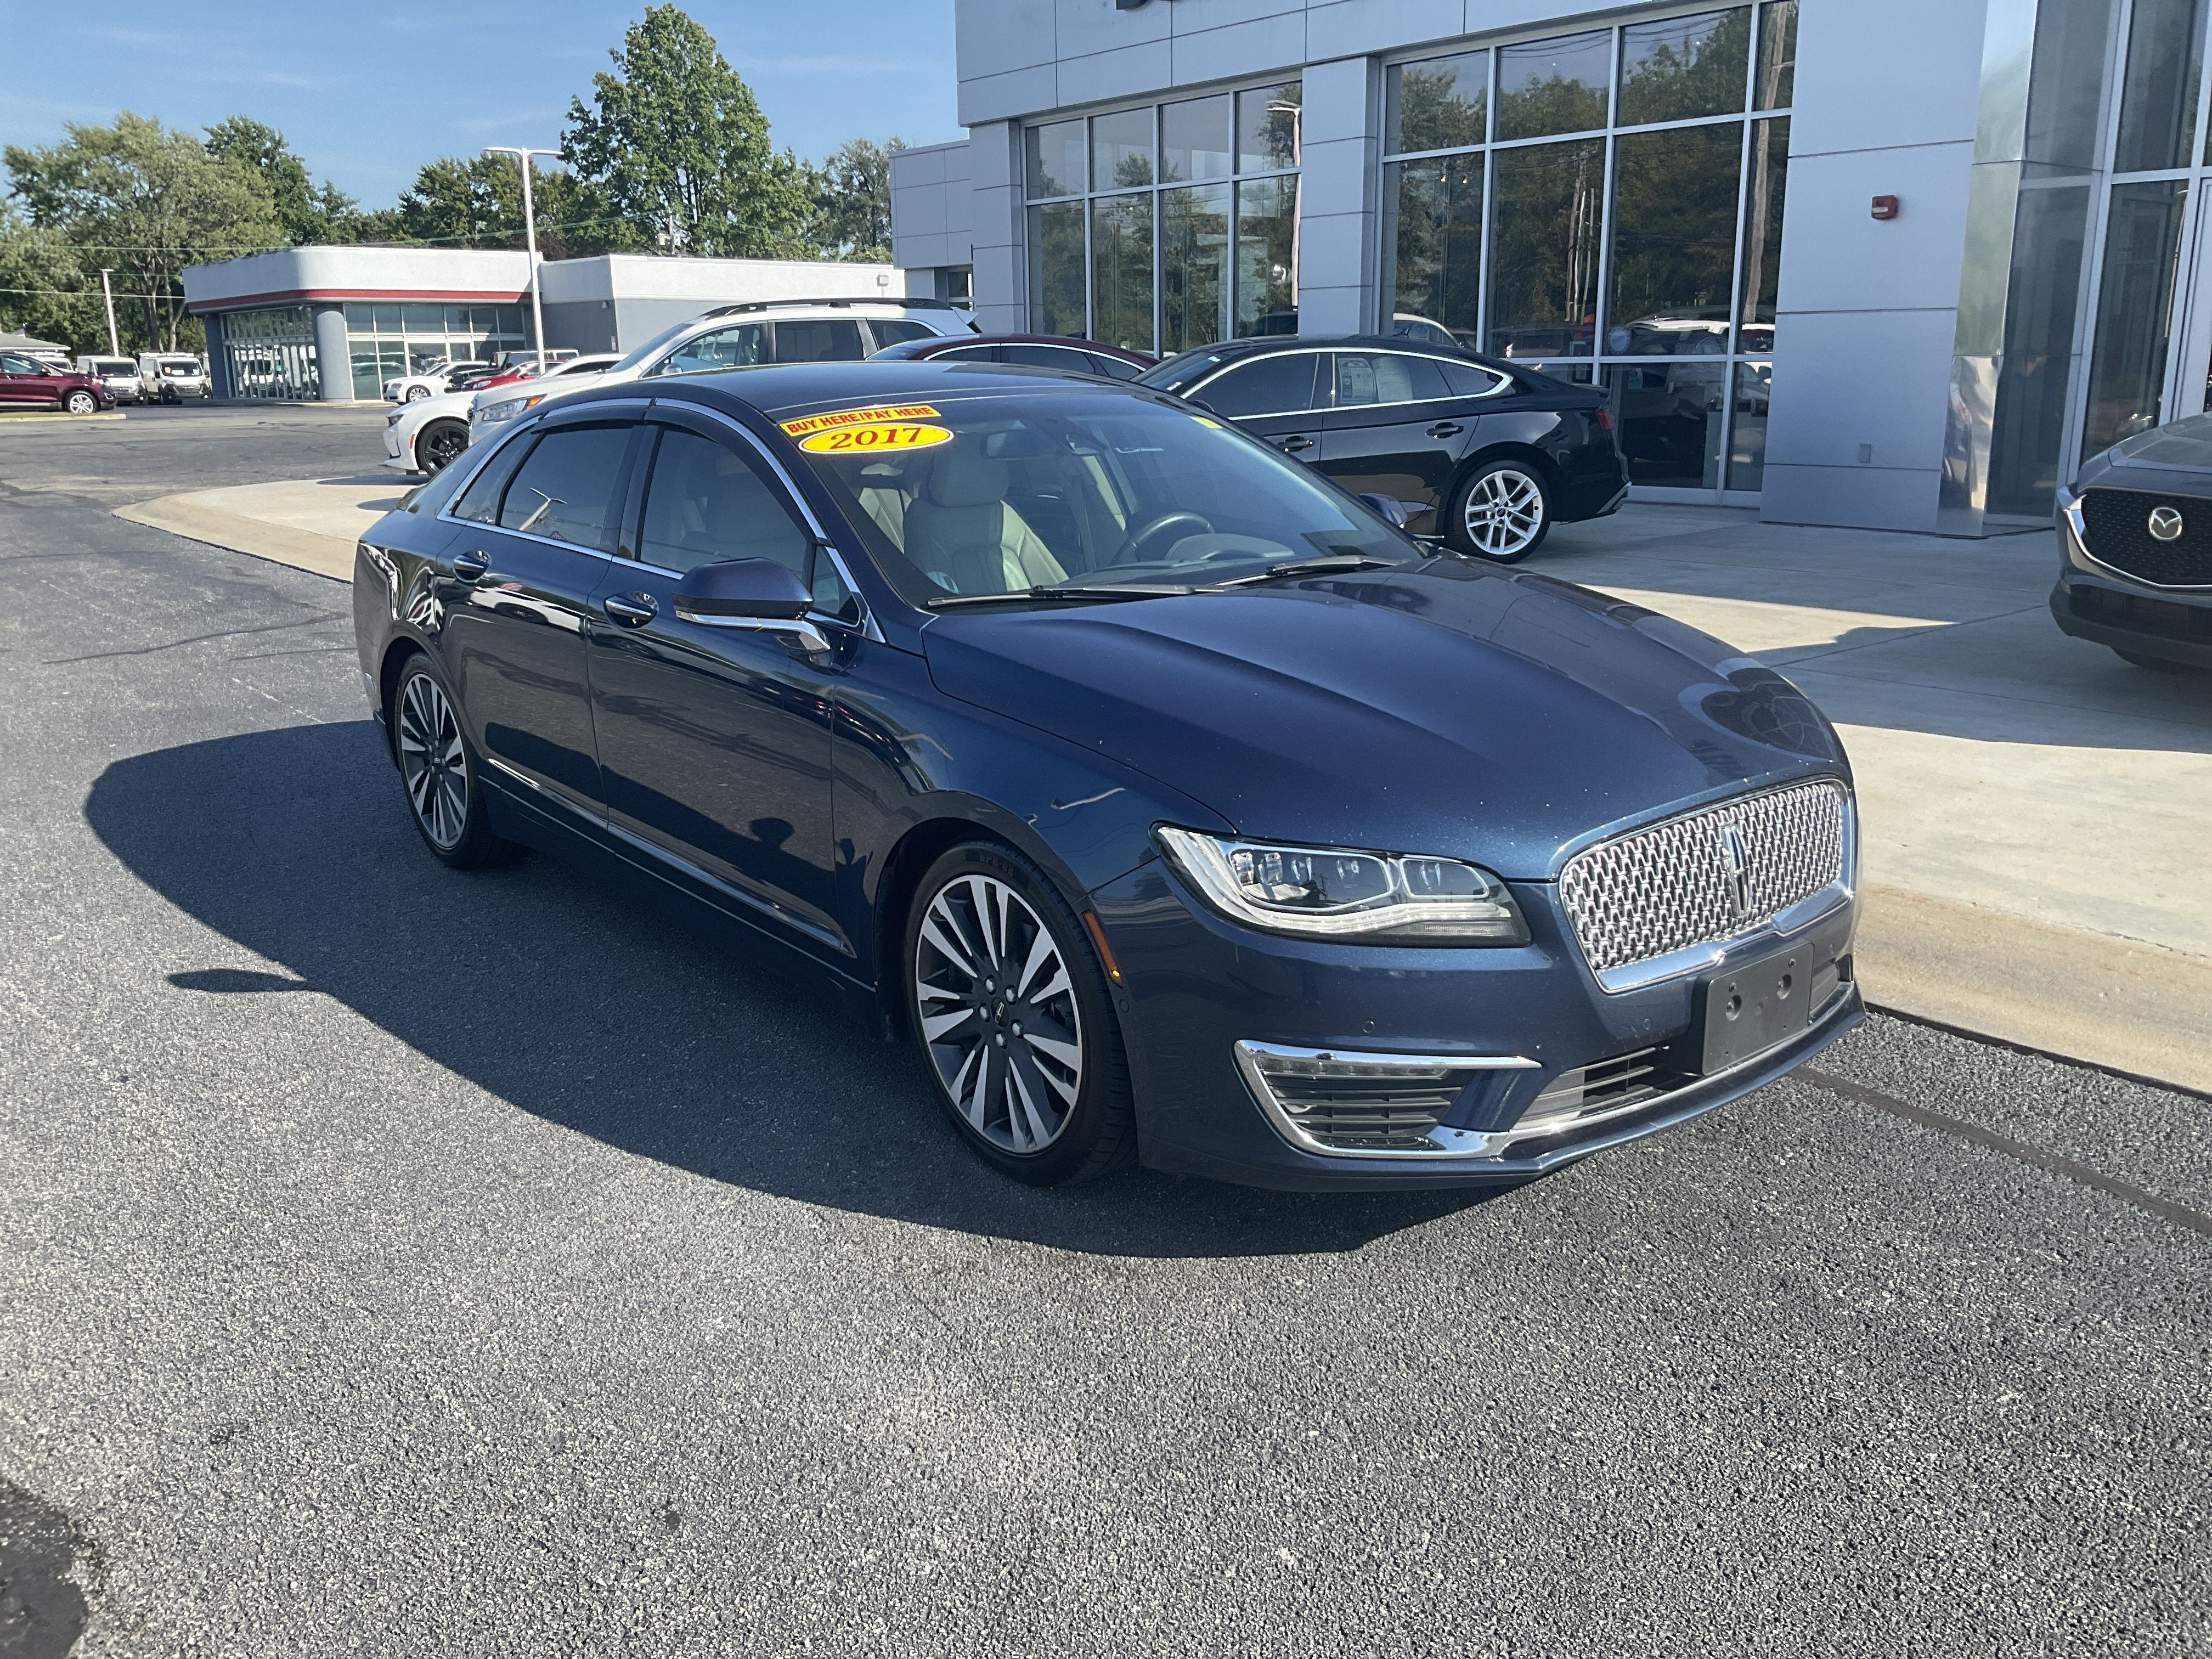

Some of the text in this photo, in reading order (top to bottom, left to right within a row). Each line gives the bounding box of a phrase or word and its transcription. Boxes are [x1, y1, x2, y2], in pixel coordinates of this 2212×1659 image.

[786, 419, 819, 433] BUY
[894, 407, 934, 417] HERE
[830, 427, 922, 449] 2017
